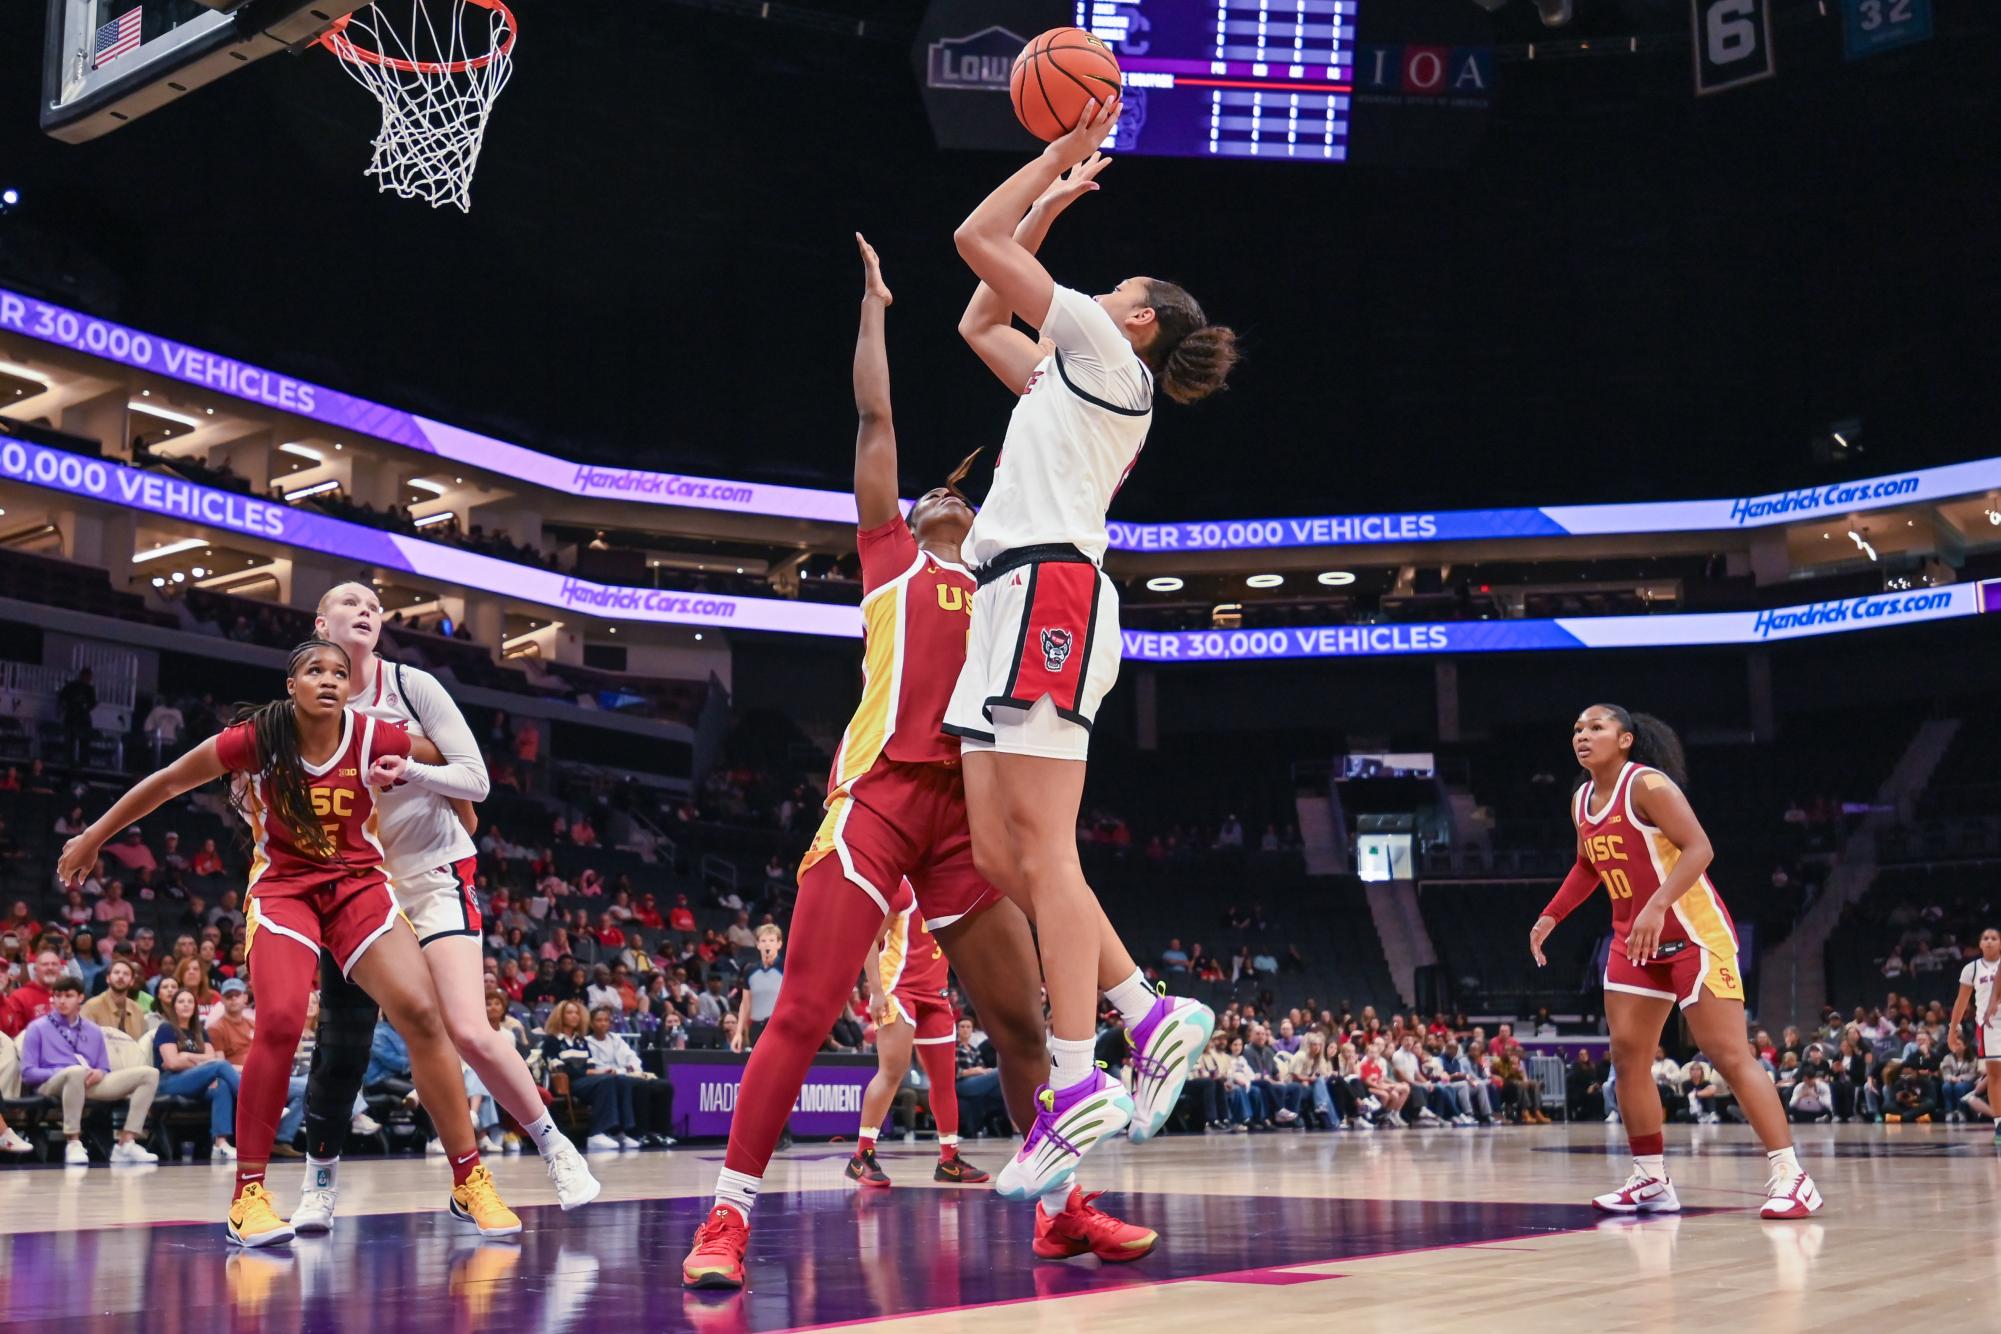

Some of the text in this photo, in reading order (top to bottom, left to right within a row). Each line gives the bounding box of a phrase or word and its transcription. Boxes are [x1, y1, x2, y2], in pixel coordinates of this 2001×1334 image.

[1859, 0, 1912, 31] 32
[1706, 0, 1757, 65] 6
[942, 49, 1013, 82] LOW
[34, 306, 152, 364] 30,000
[162, 343, 315, 412] VEHICLES
[116, 470, 284, 535] VEHICLES
[1108, 515, 1437, 548] OVER 30,000 VEHICLES
[1120, 626, 1447, 658] VER 30,000 VEHICLES
[1584, 834, 1629, 864] USC
[1601, 868, 1633, 900] 10
[801, 1084, 862, 1112] MOMENT
